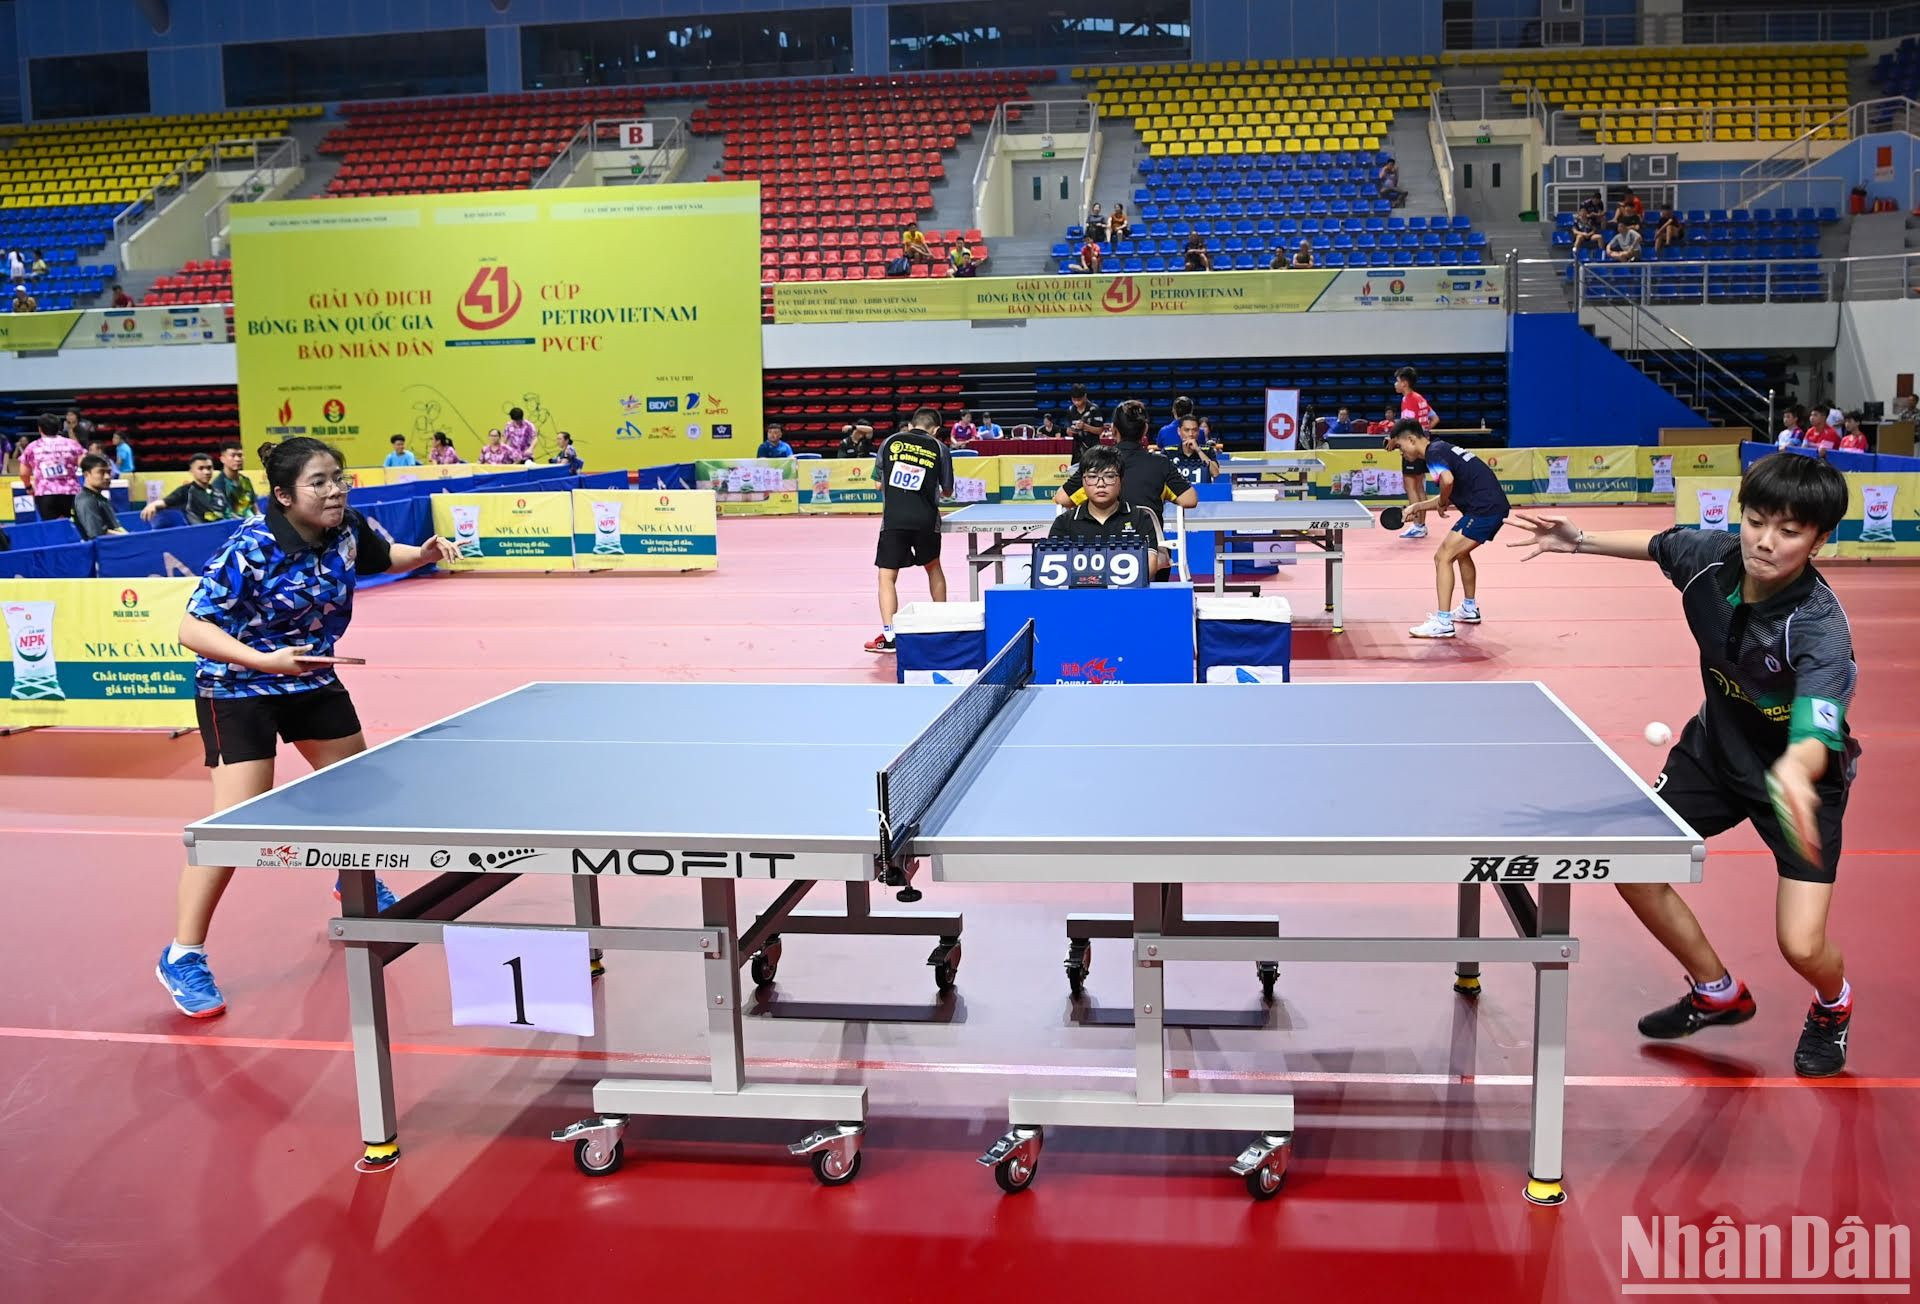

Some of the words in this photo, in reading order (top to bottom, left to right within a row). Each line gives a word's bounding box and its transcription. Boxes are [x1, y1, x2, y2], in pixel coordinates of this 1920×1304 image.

[628, 127, 643, 144] B
[465, 267, 509, 314] 41
[541, 281, 580, 301] CÚP
[977, 292, 1008, 303] BÓNG
[1073, 291, 1092, 301] GIA
[1106, 276, 1133, 303] 41
[1150, 288, 1243, 299] PETROVIETNAM
[1034, 303, 1065, 314] NHÂN
[1151, 301, 1185, 311] PVCFC
[248, 317, 297, 335] BÓNG
[304, 314, 340, 333] BÀN
[346, 311, 396, 334] QUỐC
[402, 314, 433, 330] GIA
[542, 305, 698, 327] PETROVIETNAM
[299, 341, 333, 360] BÁO
[340, 340, 390, 358] NHÂN
[396, 339, 434, 357] DÂN
[542, 336, 603, 353] PVCFC
[649, 400, 668, 410] BIDV
[890, 453, 898, 461] LÊ
[893, 471, 920, 488] 092
[862, 492, 877, 500] BIO
[1870, 504, 1888, 512] NPK
[638, 524, 656, 532] NPK
[1039, 554, 1068, 586] 5
[1109, 553, 1139, 585] 9
[20, 633, 45, 647] NPK
[85, 642, 119, 657] NPK
[124, 639, 145, 657] CÀ
[92, 670, 117, 681] Chất
[118, 671, 149, 683] lượng
[150, 671, 161, 681] đi
[105, 685, 122, 697] giá
[123, 684, 135, 696] trị
[137, 682, 157, 694] bền
[159, 684, 176, 694] lâu
[305, 848, 370, 867] DOUBLE
[375, 853, 409, 868] FISH
[572, 849, 795, 878] MOFIT
[1462, 855, 1540, 881] 双鱼
[1552, 859, 1610, 880] 235
[502, 956, 534, 1026] 1
